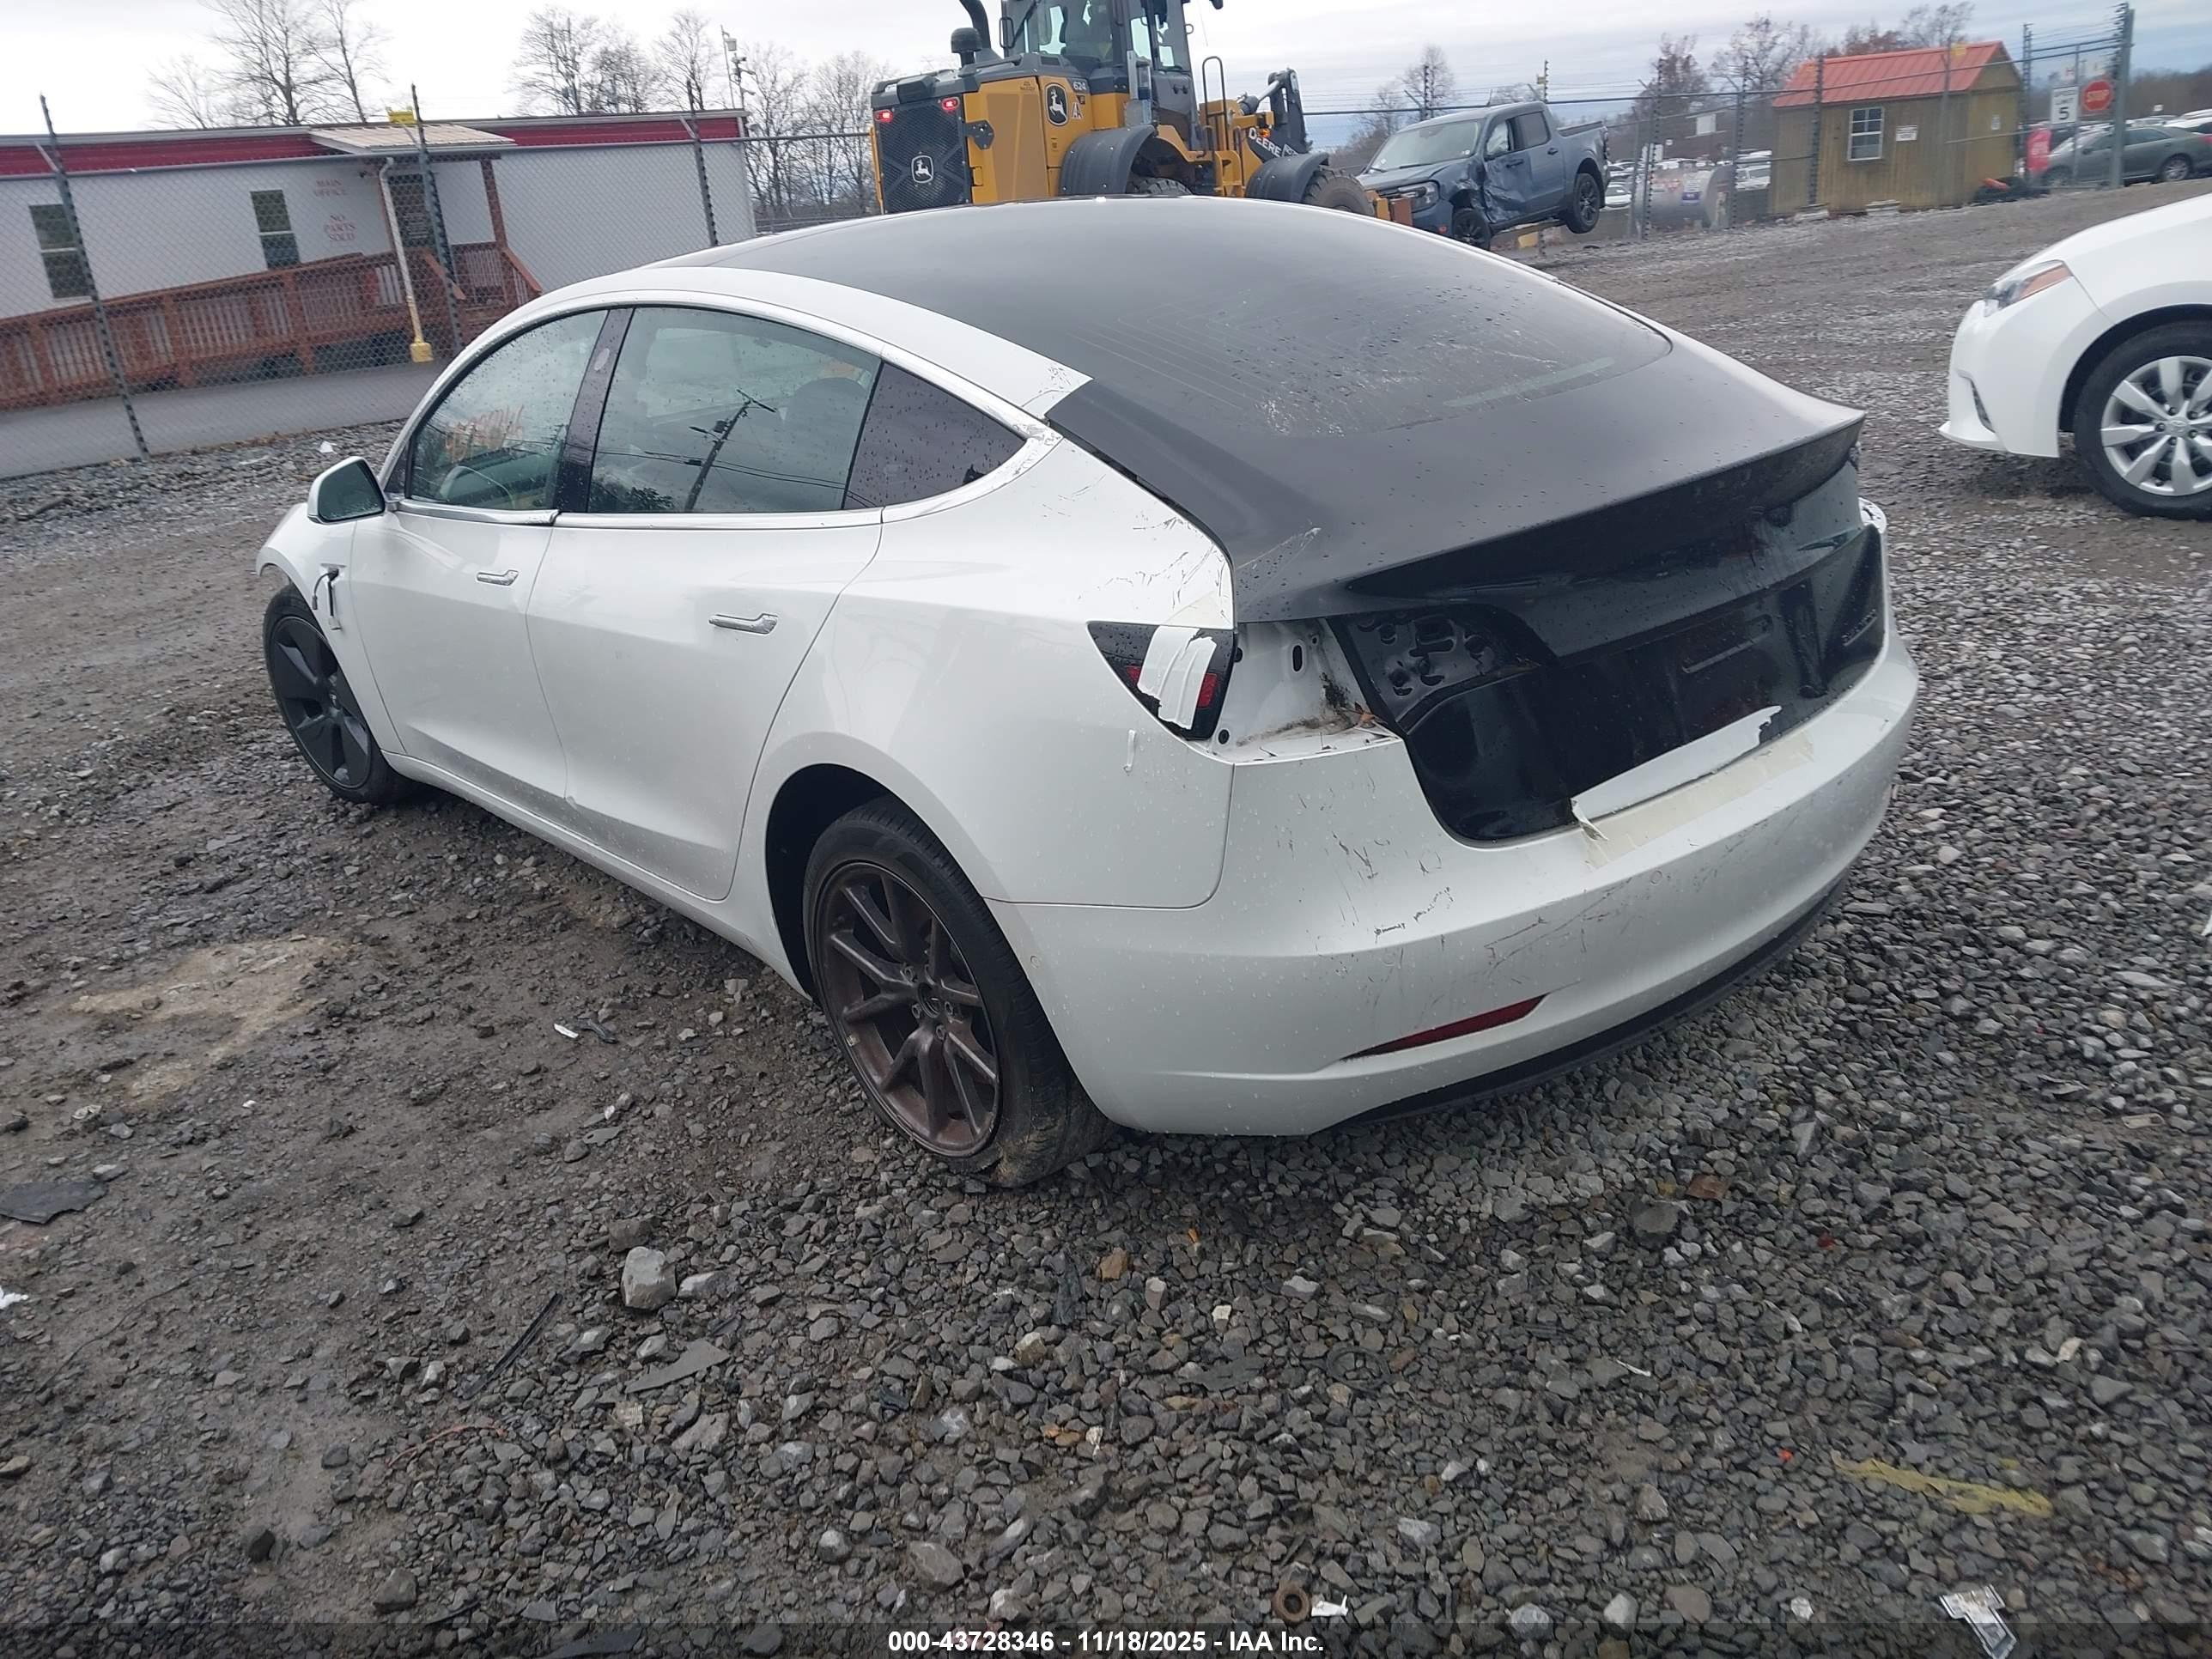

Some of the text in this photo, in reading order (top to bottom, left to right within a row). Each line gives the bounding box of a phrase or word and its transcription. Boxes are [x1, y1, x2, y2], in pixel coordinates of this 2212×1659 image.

[2058, 106, 2069, 120] 5
[1249, 127, 1282, 158] DEERE
[330, 213, 345, 222] NO
